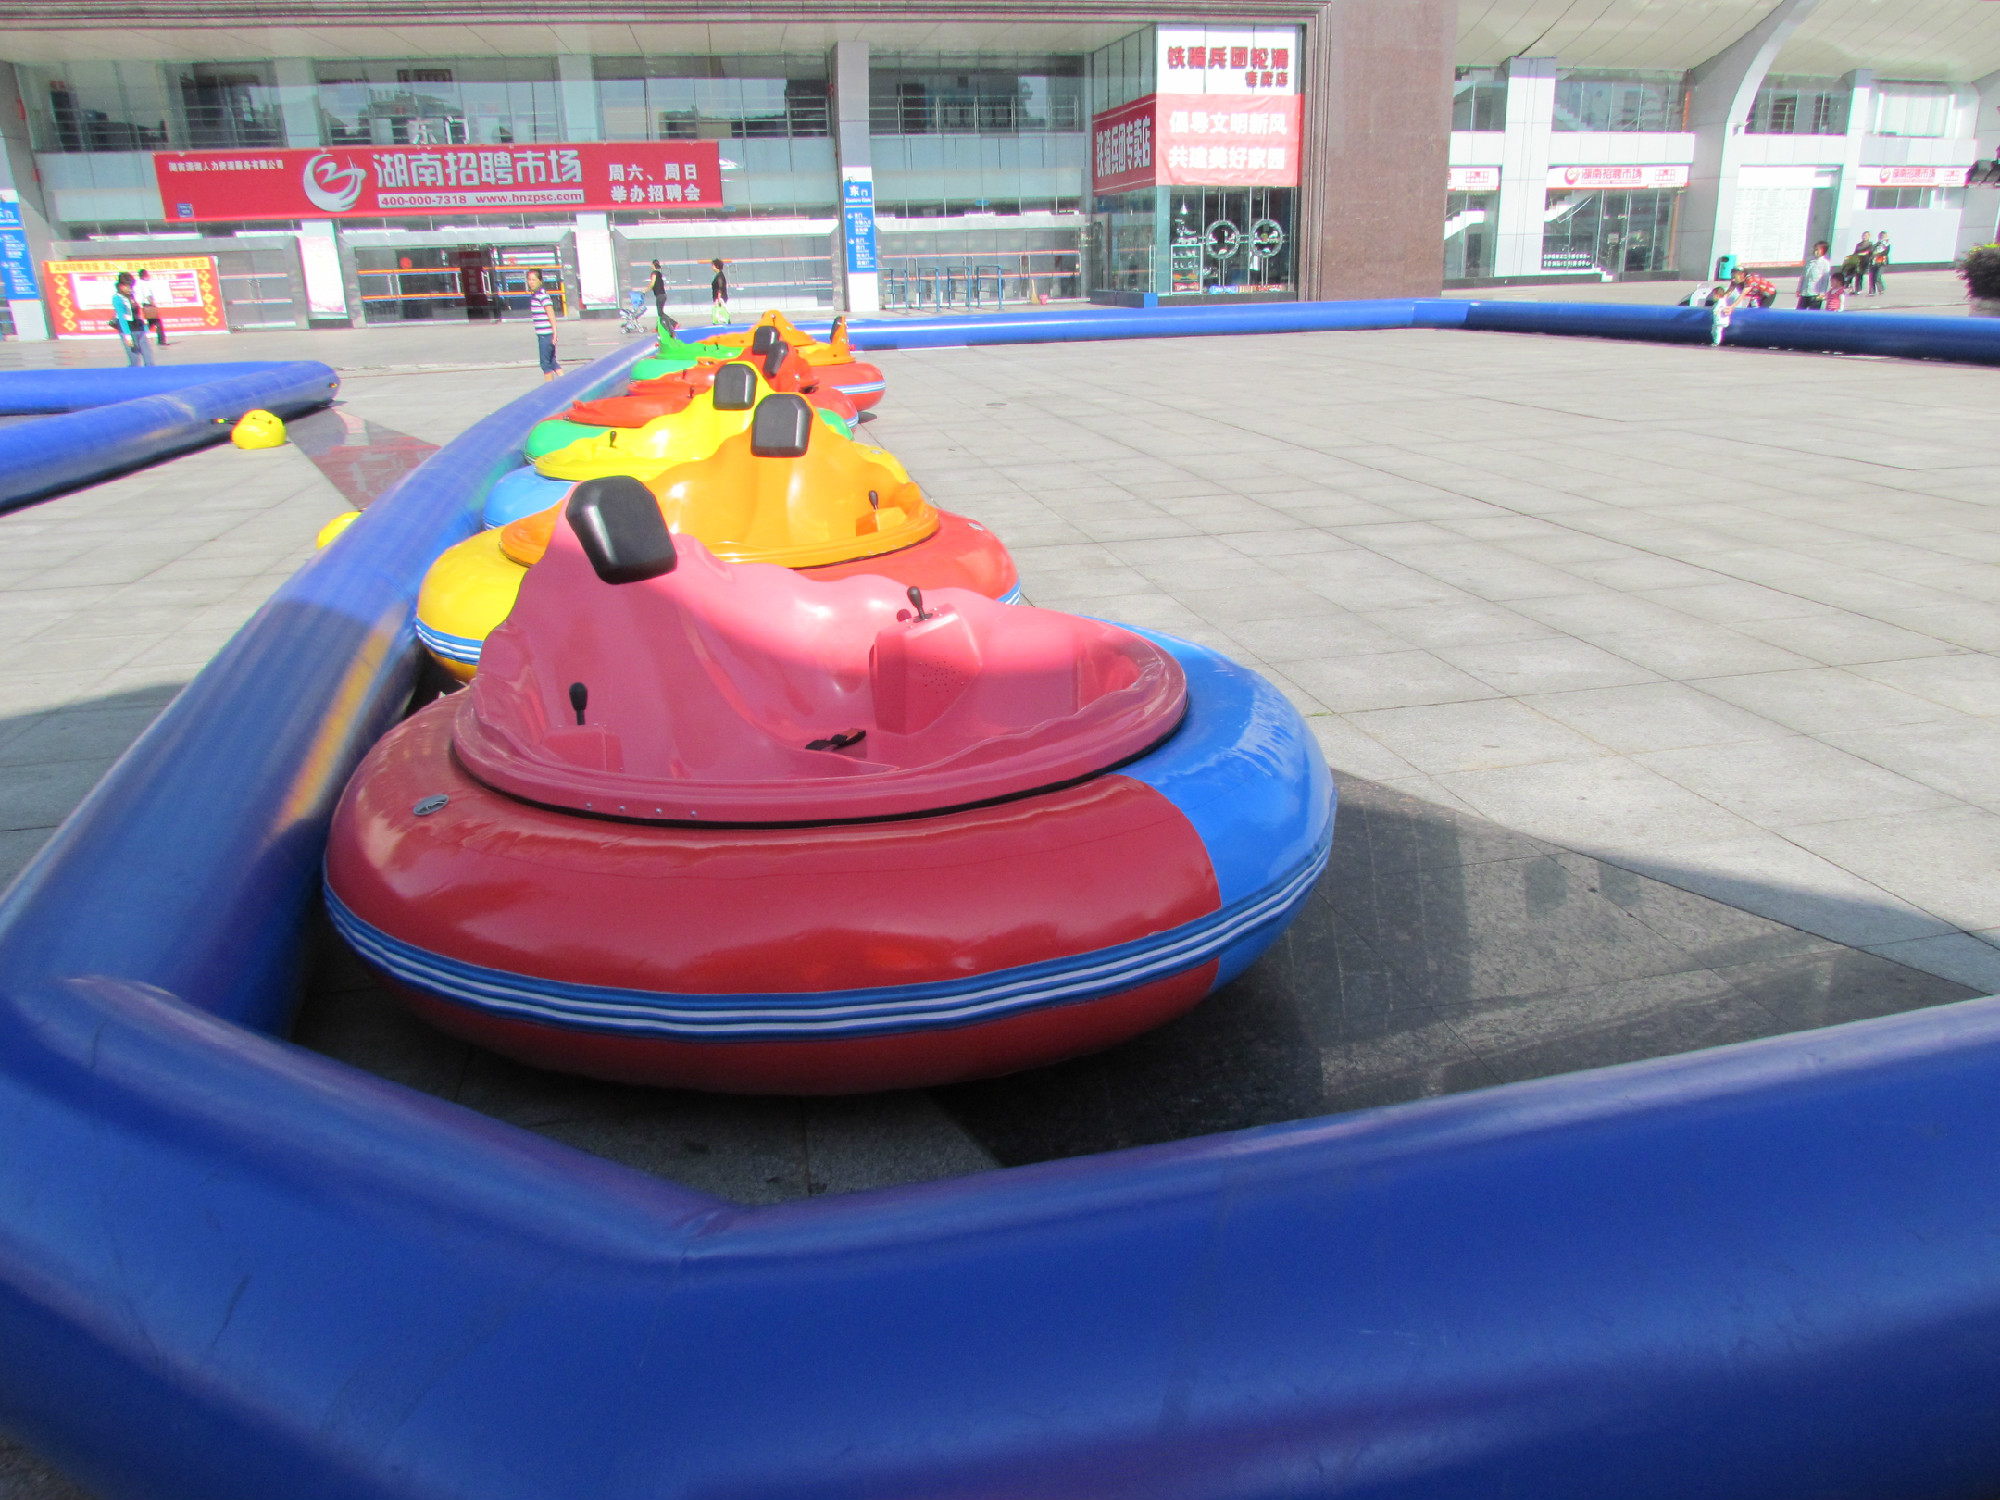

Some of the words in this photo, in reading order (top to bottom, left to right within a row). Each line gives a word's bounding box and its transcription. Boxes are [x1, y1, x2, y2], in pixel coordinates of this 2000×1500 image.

[1169, 111, 1287, 135] 倡导文明新风
[1168, 144, 1286, 169] 共建美好家园
[373, 150, 583, 188] 湖南招聘市场
[608, 163, 698, 182] 周六、周日
[381, 195, 468, 207] 400-000-7318
[475, 191, 583, 205] www.hnzpsc.com
[610, 184, 701, 203] 举办招聘会
